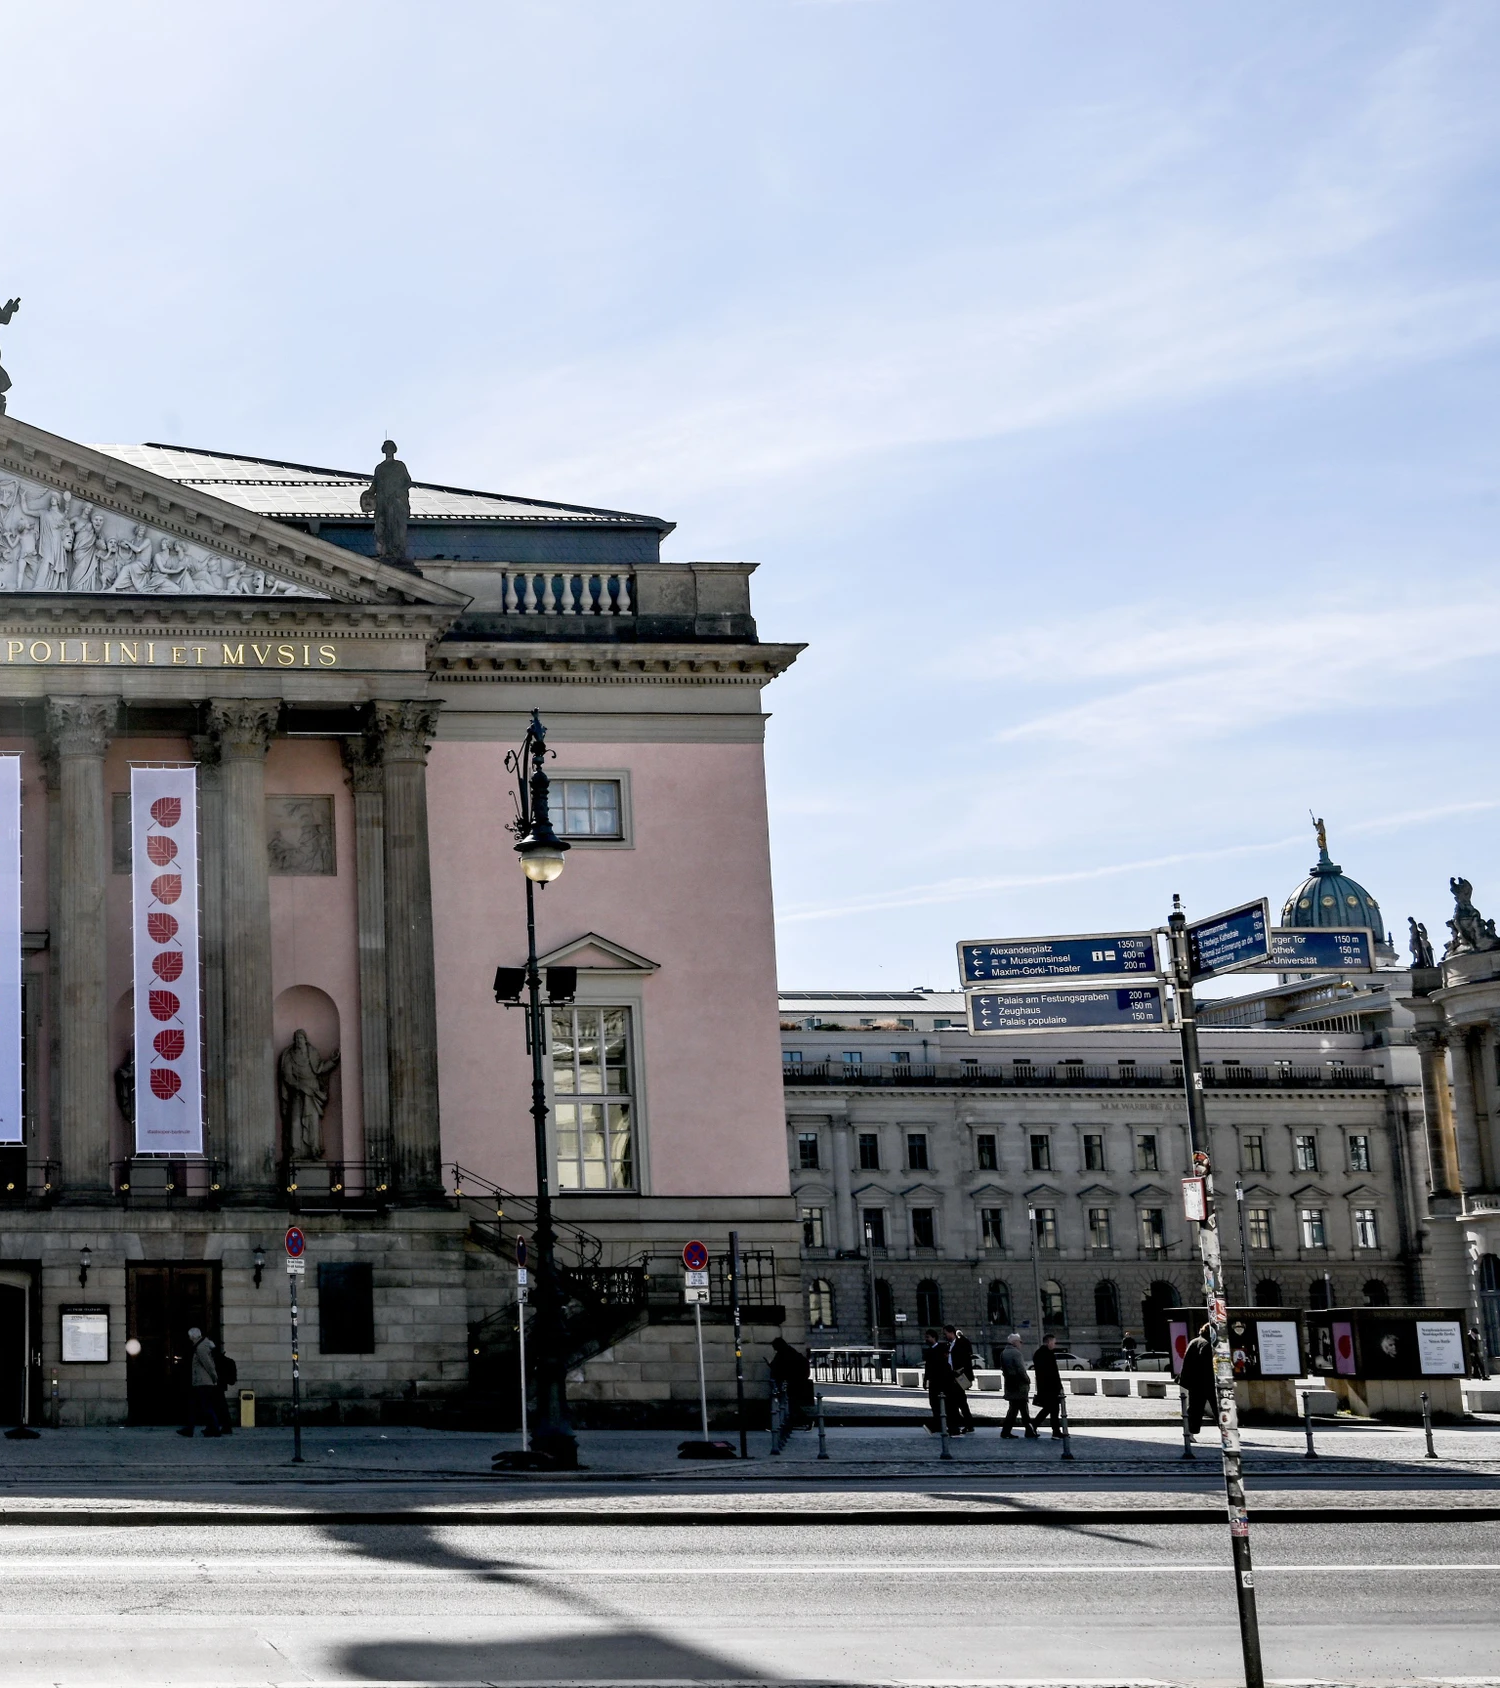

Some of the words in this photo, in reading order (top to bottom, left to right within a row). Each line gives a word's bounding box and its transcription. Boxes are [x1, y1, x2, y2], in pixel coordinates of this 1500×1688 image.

[172, 646, 207, 664] ET
[222, 643, 337, 666] MVSIS
[1292, 935, 1306, 943] Tor
[1334, 935, 1351, 943] 1150
[990, 944, 1053, 955] Alexanderplatz
[1117, 941, 1135, 949] 1350
[1339, 946, 1352, 954] 150
[1010, 954, 1070, 965] Museumsinsel
[1122, 951, 1137, 959] 400
[991, 964, 1081, 976] Maxim-Gorki-Theater
[1124, 961, 1138, 969] 200
[997, 996, 1024, 1005] Palais
[1041, 993, 1109, 1005] Festungsgraben
[1128, 991, 1143, 999] 200
[999, 1007, 1041, 1017] Zeughaus
[1131, 1001, 1144, 1010] 150
[1000, 1017, 1026, 1026] Palais
[1028, 1016, 1067, 1026] populaire
[1132, 1012, 1145, 1020] 150
